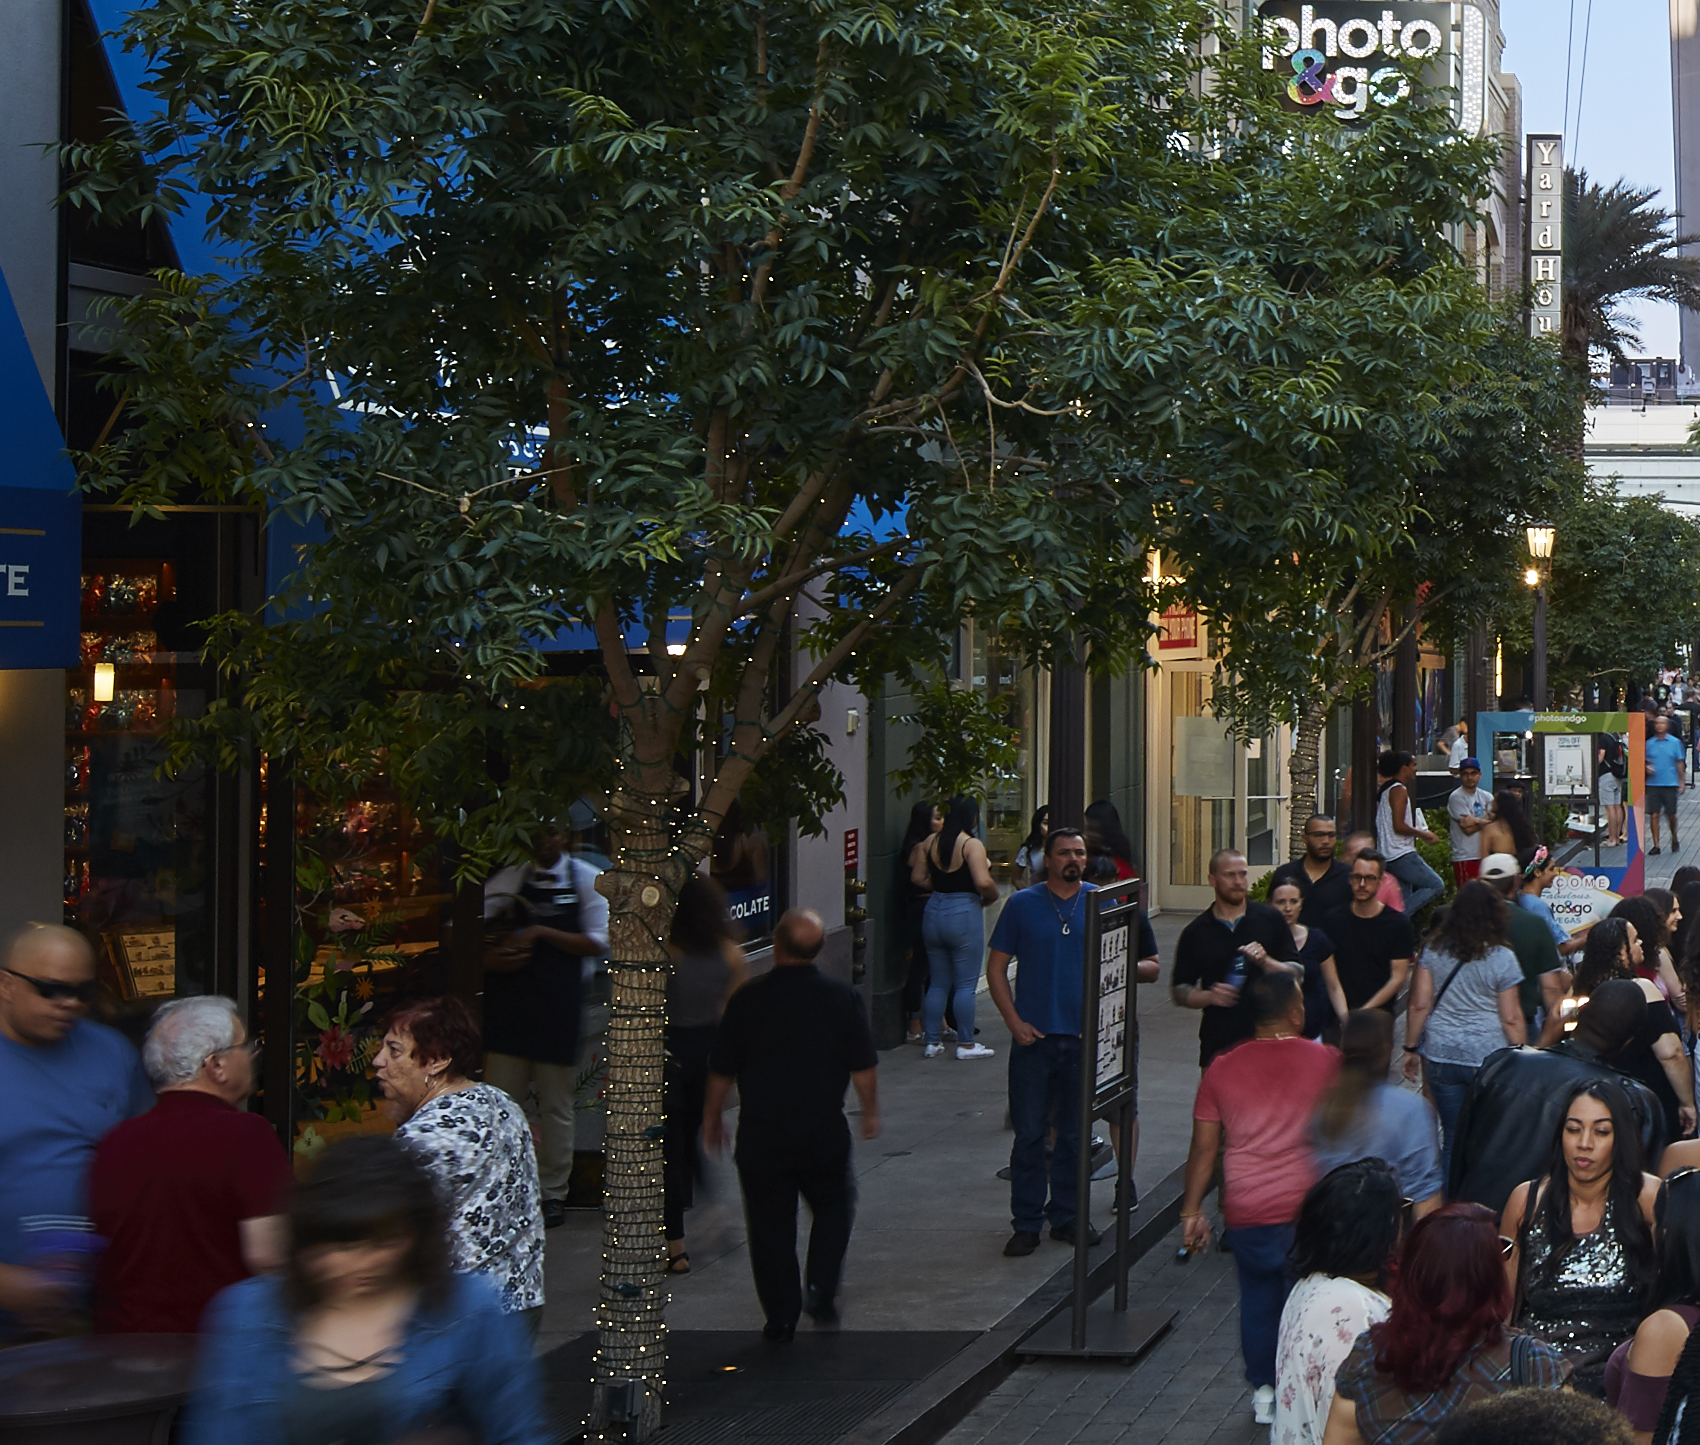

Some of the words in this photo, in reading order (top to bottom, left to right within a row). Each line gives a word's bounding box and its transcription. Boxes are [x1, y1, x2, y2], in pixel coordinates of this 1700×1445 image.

[1261, 4, 1442, 70] photo
[1535, 142, 1555, 249] Yard
[1535, 258, 1556, 335] Hou
[1528, 714, 1587, 725] #photoandgo
